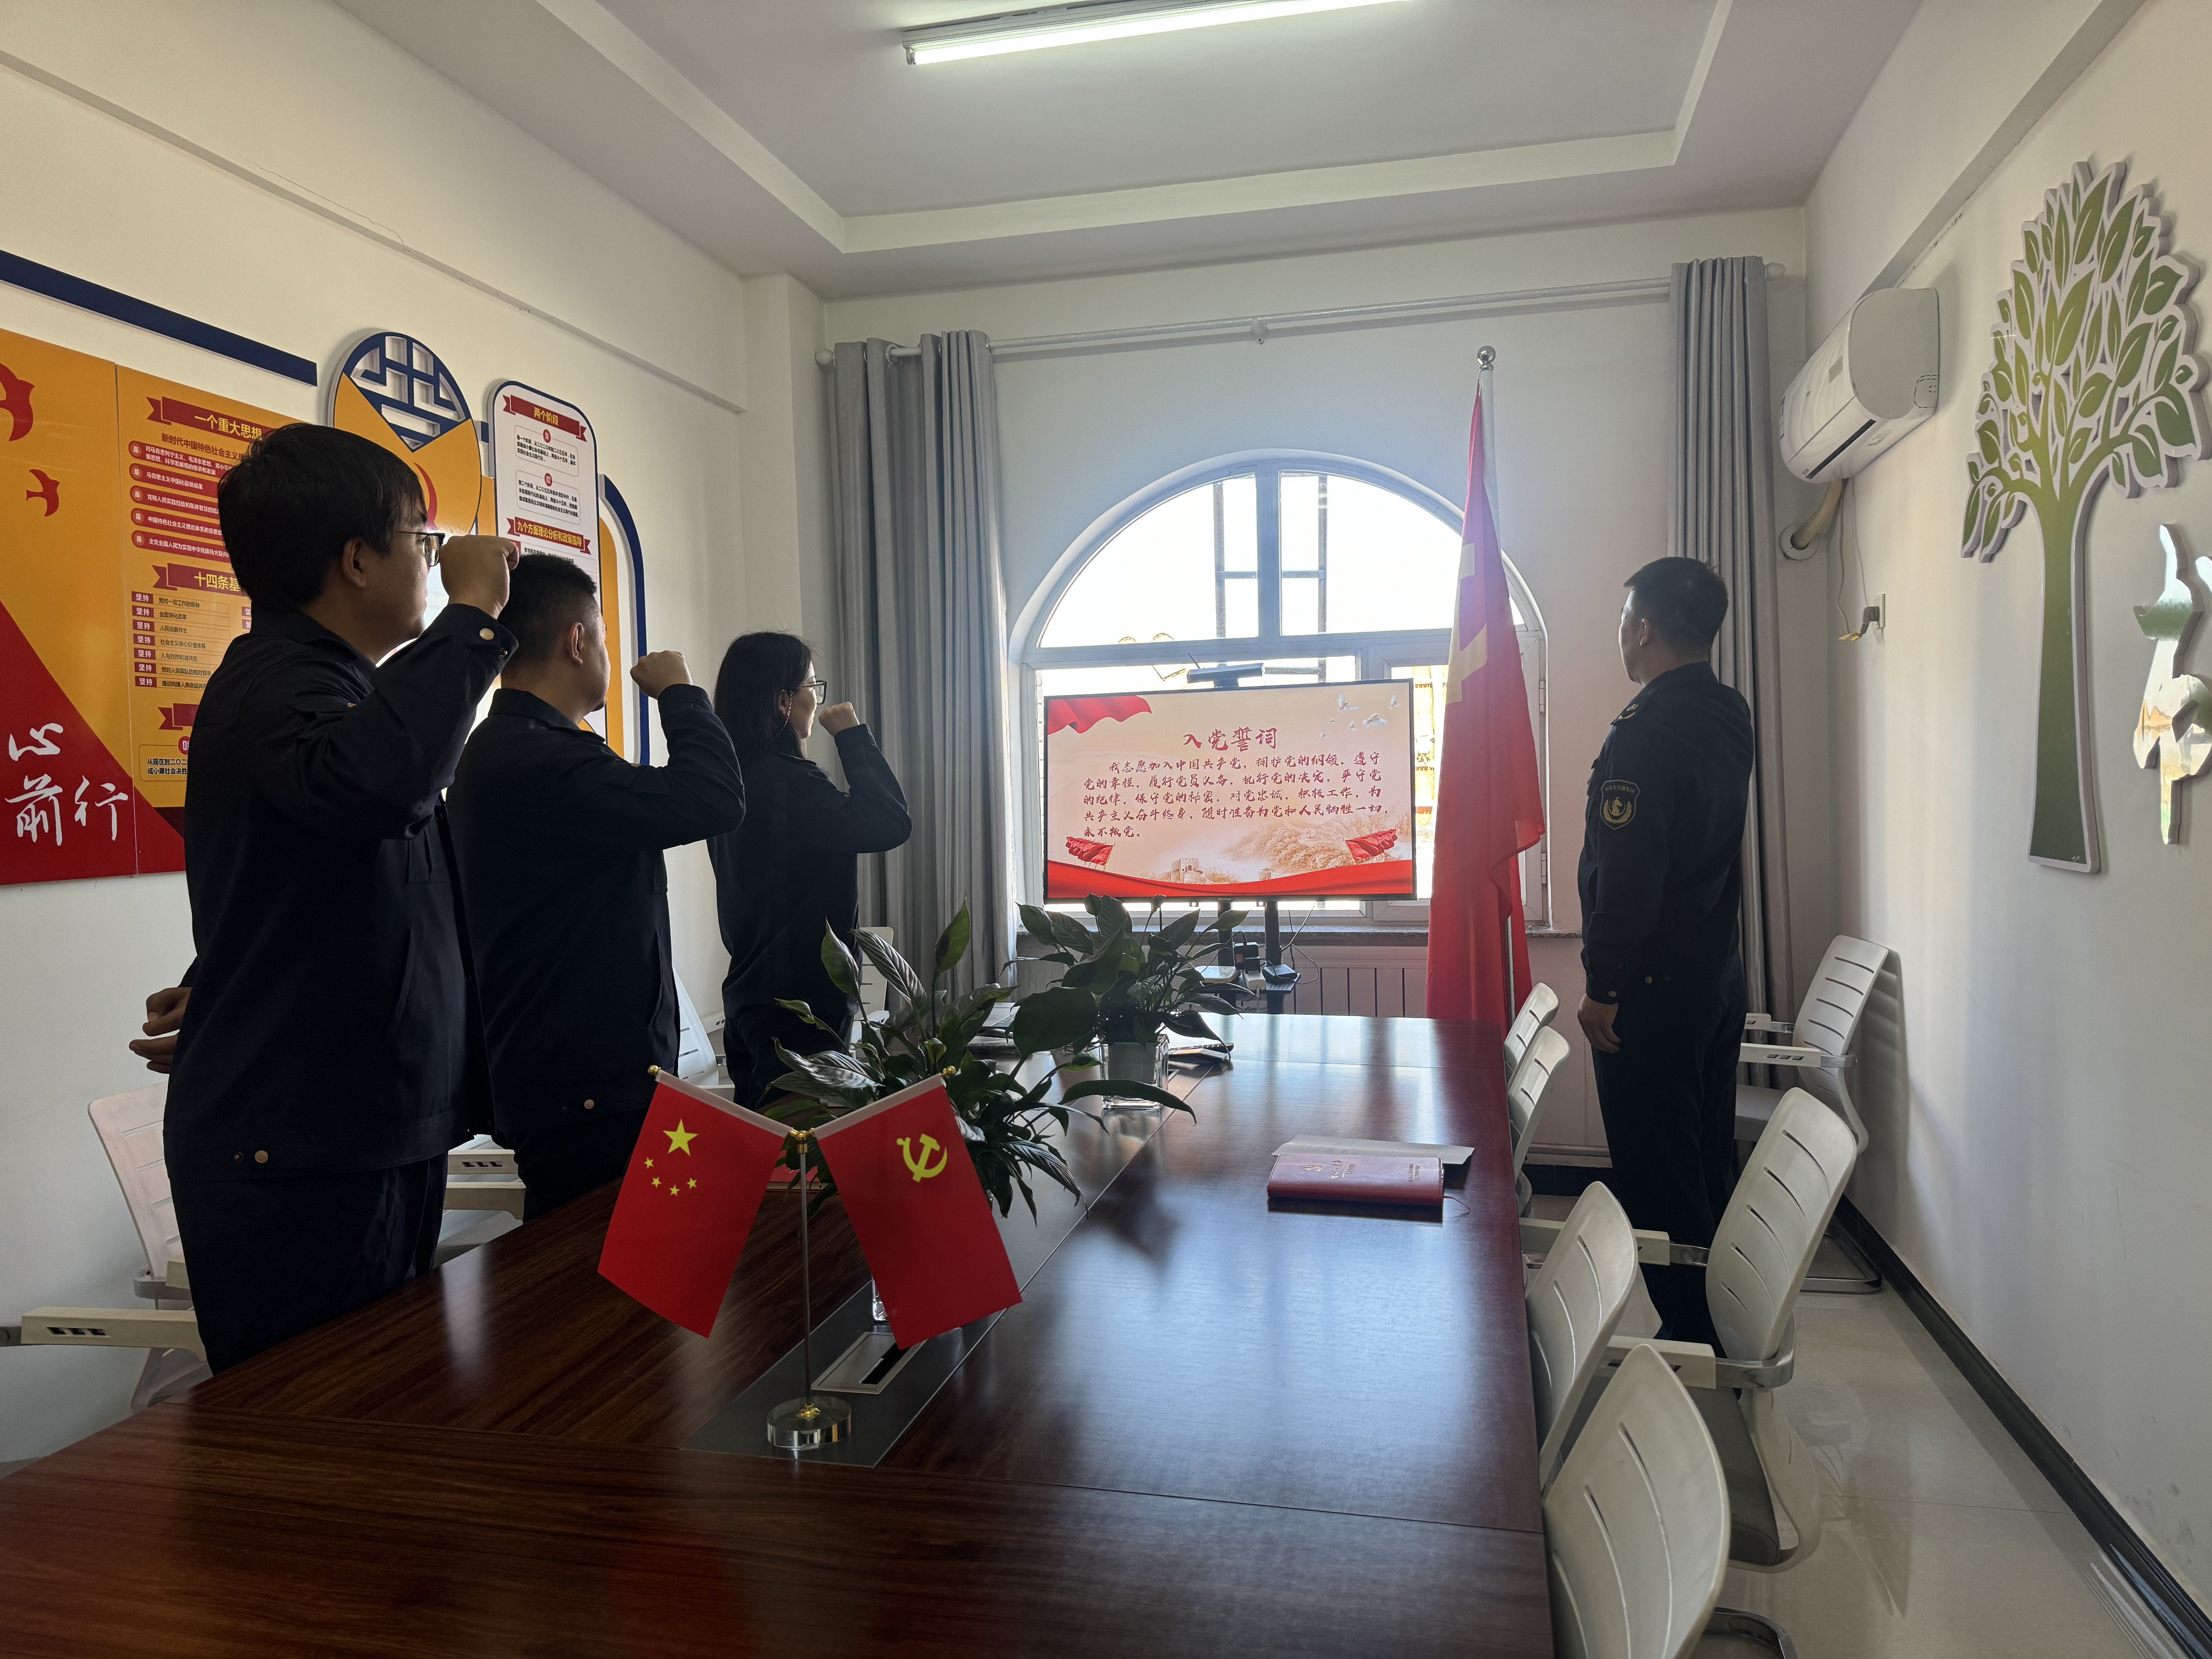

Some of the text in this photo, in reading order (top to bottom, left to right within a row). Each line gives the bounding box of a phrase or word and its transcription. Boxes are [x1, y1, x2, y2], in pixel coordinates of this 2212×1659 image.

[534, 407, 559, 426] 两个阶段
[194, 414, 262, 441] 一个重大思想
[546, 476, 551, 484] 02
[517, 520, 582, 547] 九个方面理论分析和政策指导
[194, 571, 240, 592] 十四条基
[136, 593, 149, 602] 坚持
[136, 607, 187, 620] 坚持 全面深化改革
[137, 622, 187, 634] 坚持 人民当家作主
[137, 635, 151, 644] 坚持
[138, 649, 151, 658] 坚持
[139, 664, 152, 672] 坚持
[139, 678, 153, 686] 坚持
[8, 723, 64, 761] 心
[1183, 726, 1278, 752] 入党誓词
[5, 773, 129, 847] 前行
[1083, 825, 1140, 837] 永不叛党。
